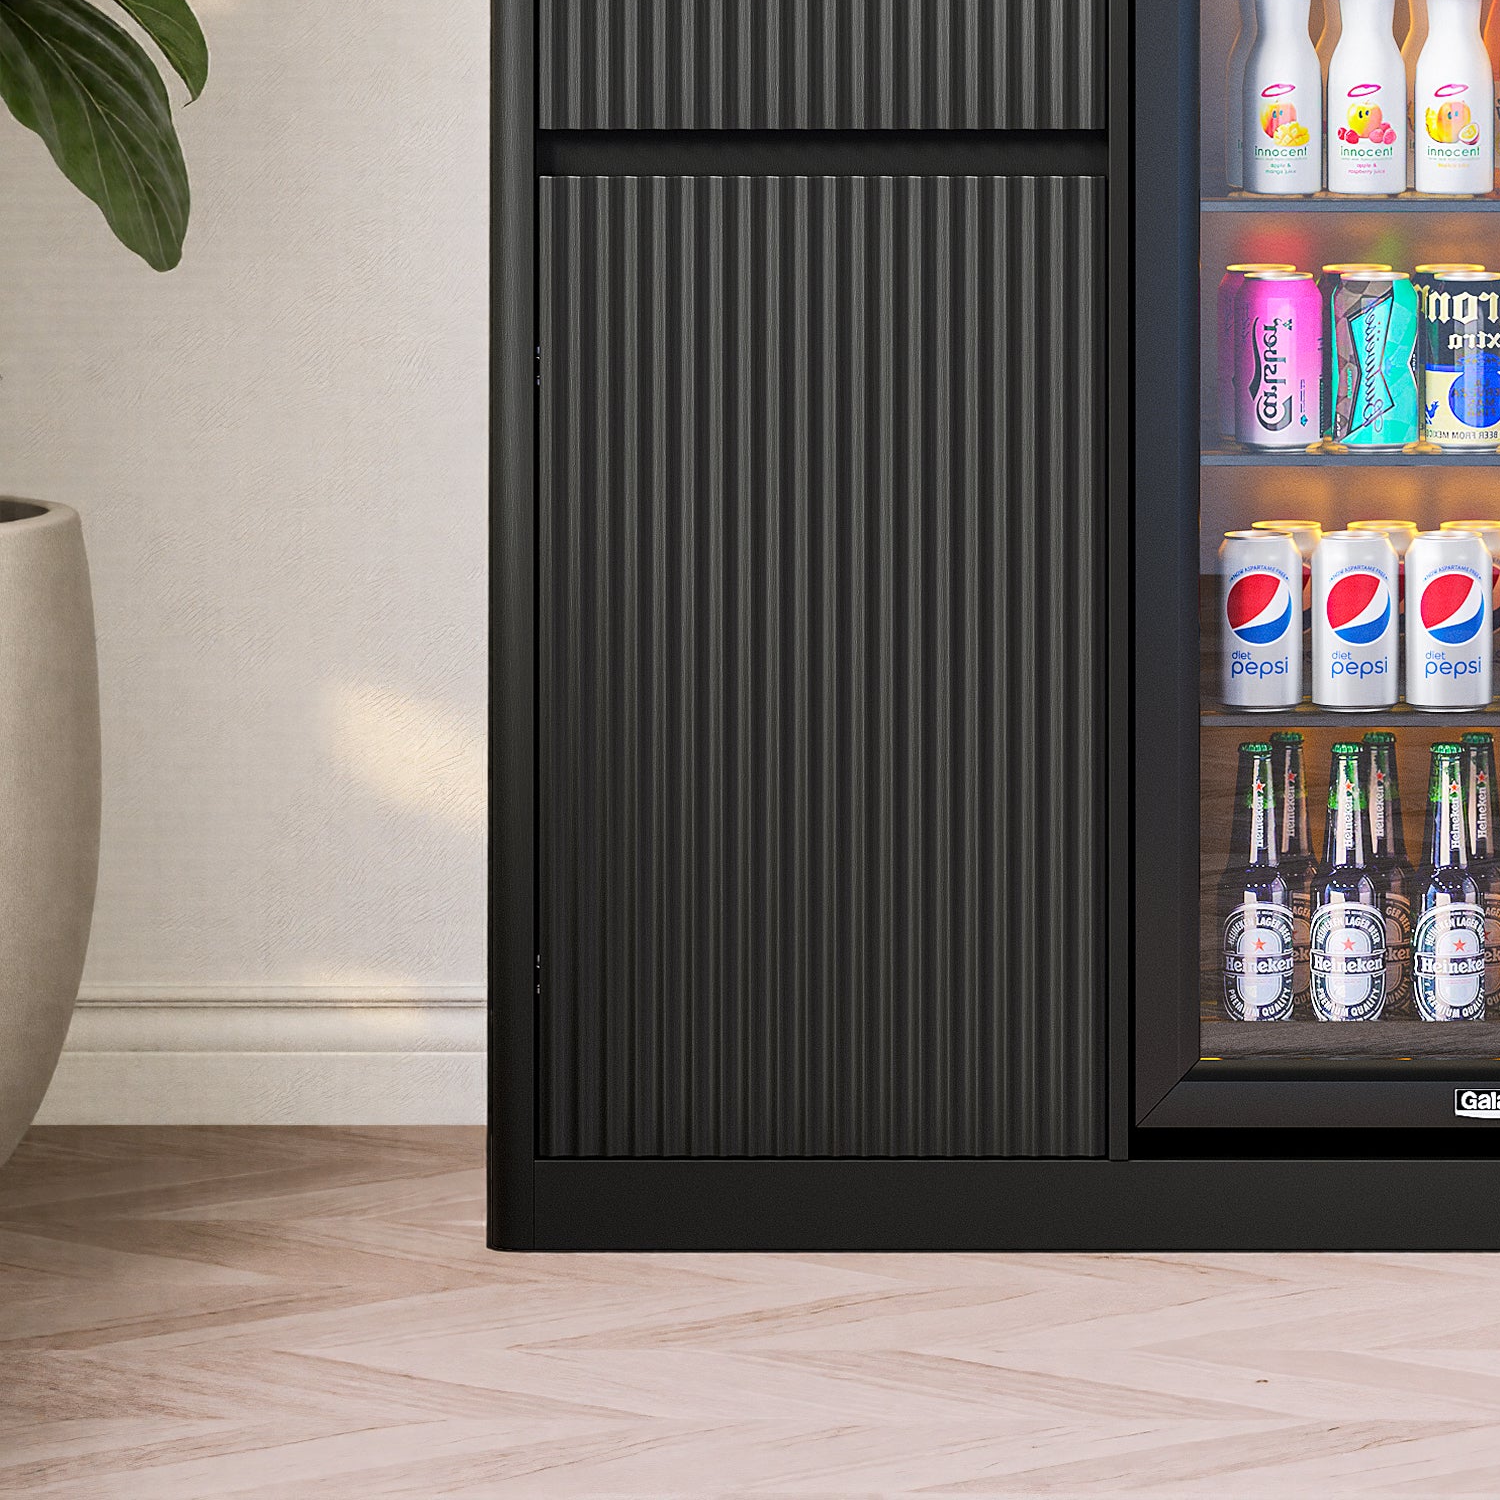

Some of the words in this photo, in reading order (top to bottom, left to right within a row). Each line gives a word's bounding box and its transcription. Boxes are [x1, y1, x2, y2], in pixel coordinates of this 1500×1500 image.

[1254, 146, 1307, 157] innocent
[1340, 146, 1393, 157] innocent
[1427, 146, 1480, 157] innocent
[1231, 650, 1252, 660] diet
[1331, 650, 1352, 660] diet
[1425, 650, 1446, 660] diet
[1231, 656, 1289, 679] pepsi
[1331, 656, 1388, 679] pepsi
[1425, 656, 1482, 679] pepsi
[1450, 794, 1461, 850] Heineken
[1477, 786, 1487, 839] Heineken
[1386, 906, 1399, 918] GER
[1256, 916, 1280, 930] LAGER
[1279, 922, 1292, 944] BEER
[1345, 916, 1370, 930] LAGER
[1369, 922, 1381, 945] BEER
[1456, 917, 1479, 930] LAGER
[1225, 956, 1294, 973] Heineken
[1314, 954, 1383, 973] Heineken
[1261, 987, 1291, 1018] QUALITY
[1351, 987, 1381, 1018] QUALITY
[1462, 988, 1485, 1018] QUALITY
